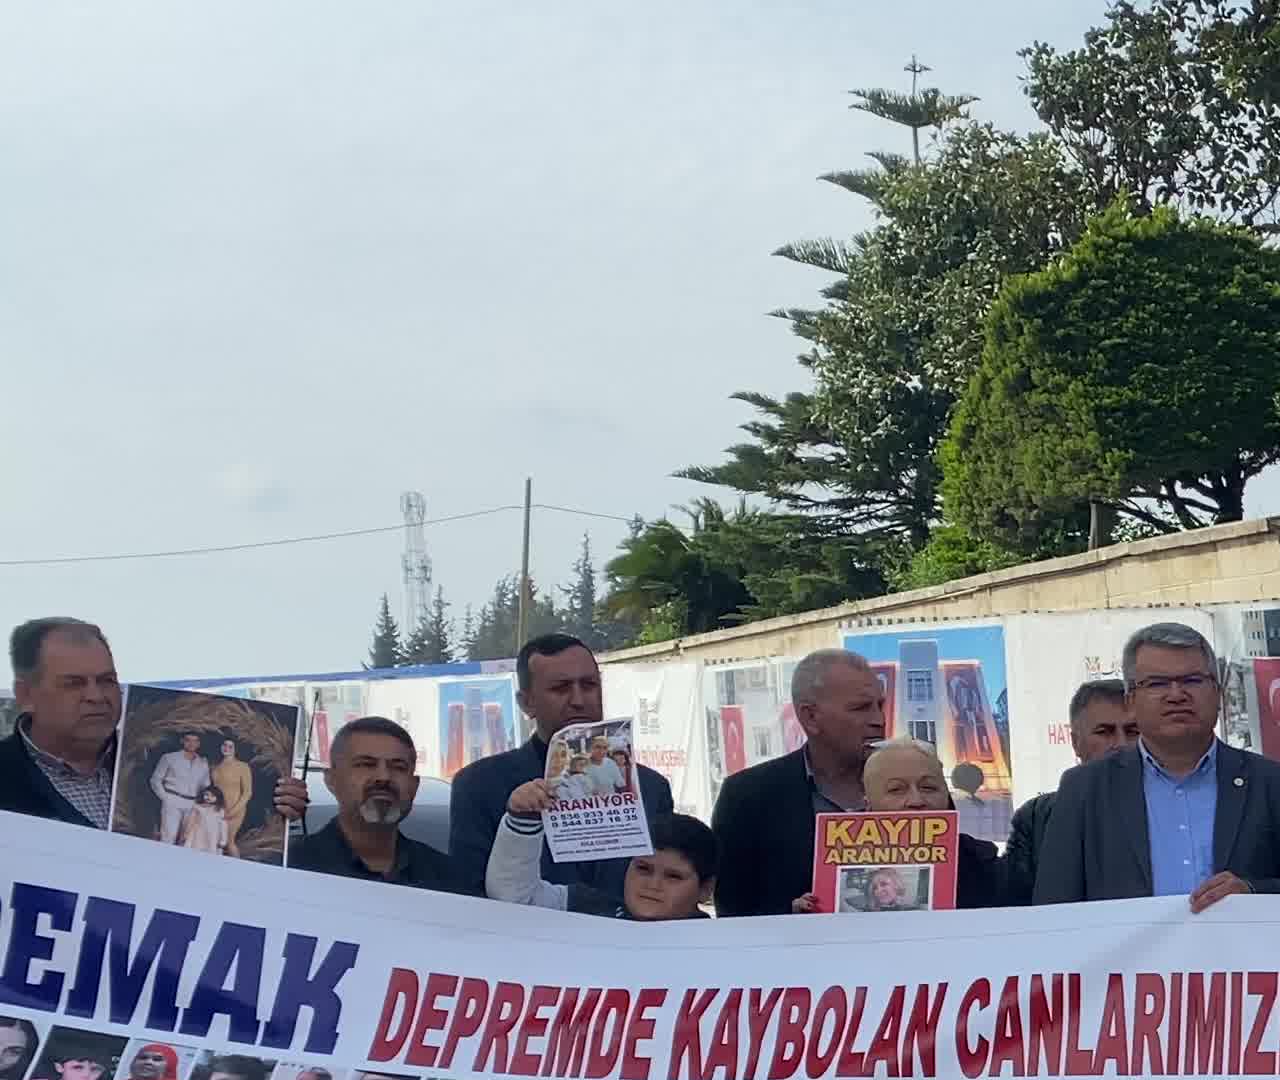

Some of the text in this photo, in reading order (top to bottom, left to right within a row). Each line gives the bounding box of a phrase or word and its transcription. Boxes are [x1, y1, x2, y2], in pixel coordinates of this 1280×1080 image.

[825, 816, 948, 847] KAYIP
[824, 846, 947, 865] ARANIYOR
[0, 881, 361, 1055] EMAK
